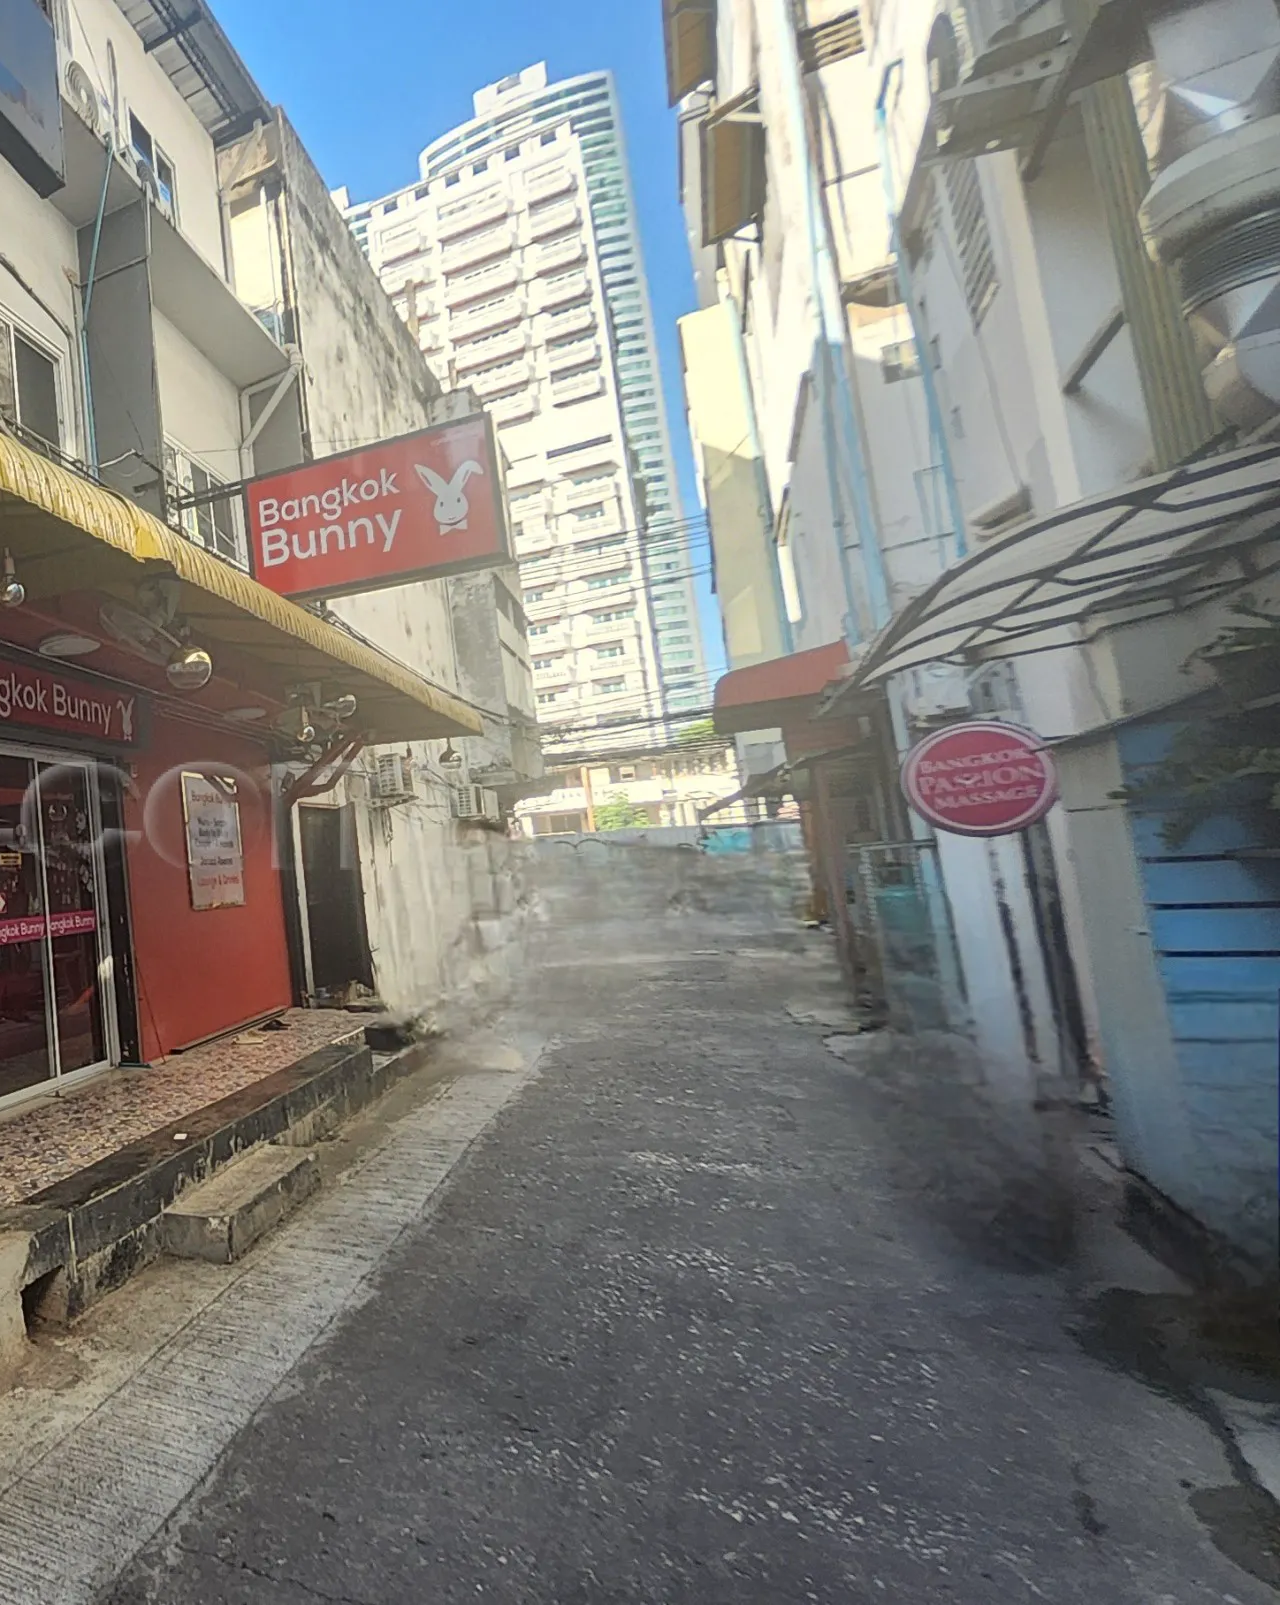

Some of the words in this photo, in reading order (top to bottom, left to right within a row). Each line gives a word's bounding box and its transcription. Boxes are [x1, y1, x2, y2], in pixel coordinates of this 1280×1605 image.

[258, 468, 401, 528] Bangkok
[260, 508, 402, 568] Bunny
[51, 687, 113, 734] Bunny
[20, 921, 44, 937] Bunny
[48, 918, 74, 934] angkok
[74, 914, 95, 929] Bunny
